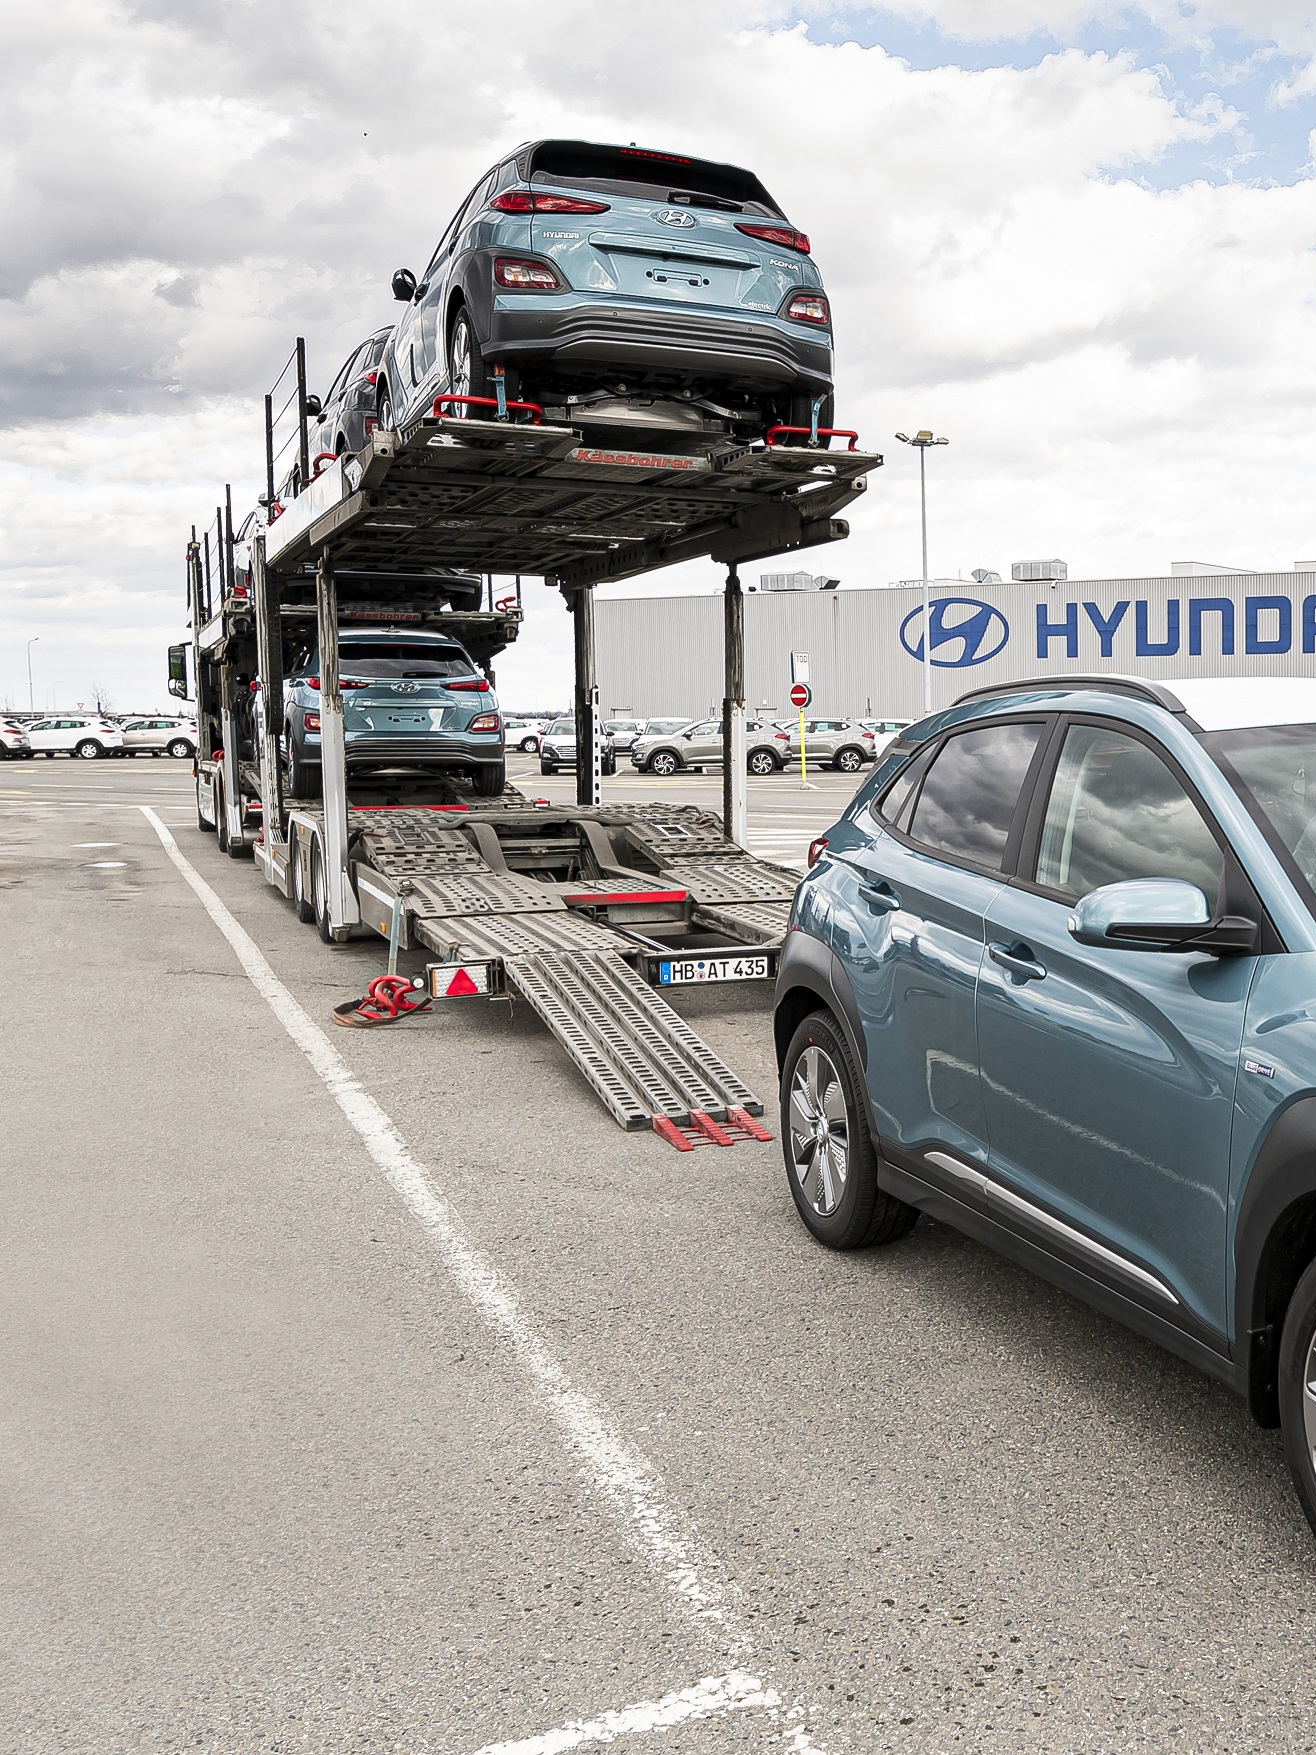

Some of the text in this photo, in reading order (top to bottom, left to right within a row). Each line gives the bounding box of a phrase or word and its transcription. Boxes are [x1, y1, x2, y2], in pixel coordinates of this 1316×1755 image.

[543, 231, 579, 239] HYUNDAI
[769, 259, 798, 271] KONA
[747, 301, 772, 310] electric
[576, 449, 693, 469] Kässbohrer
[672, 959, 765, 980] HB AT 435
